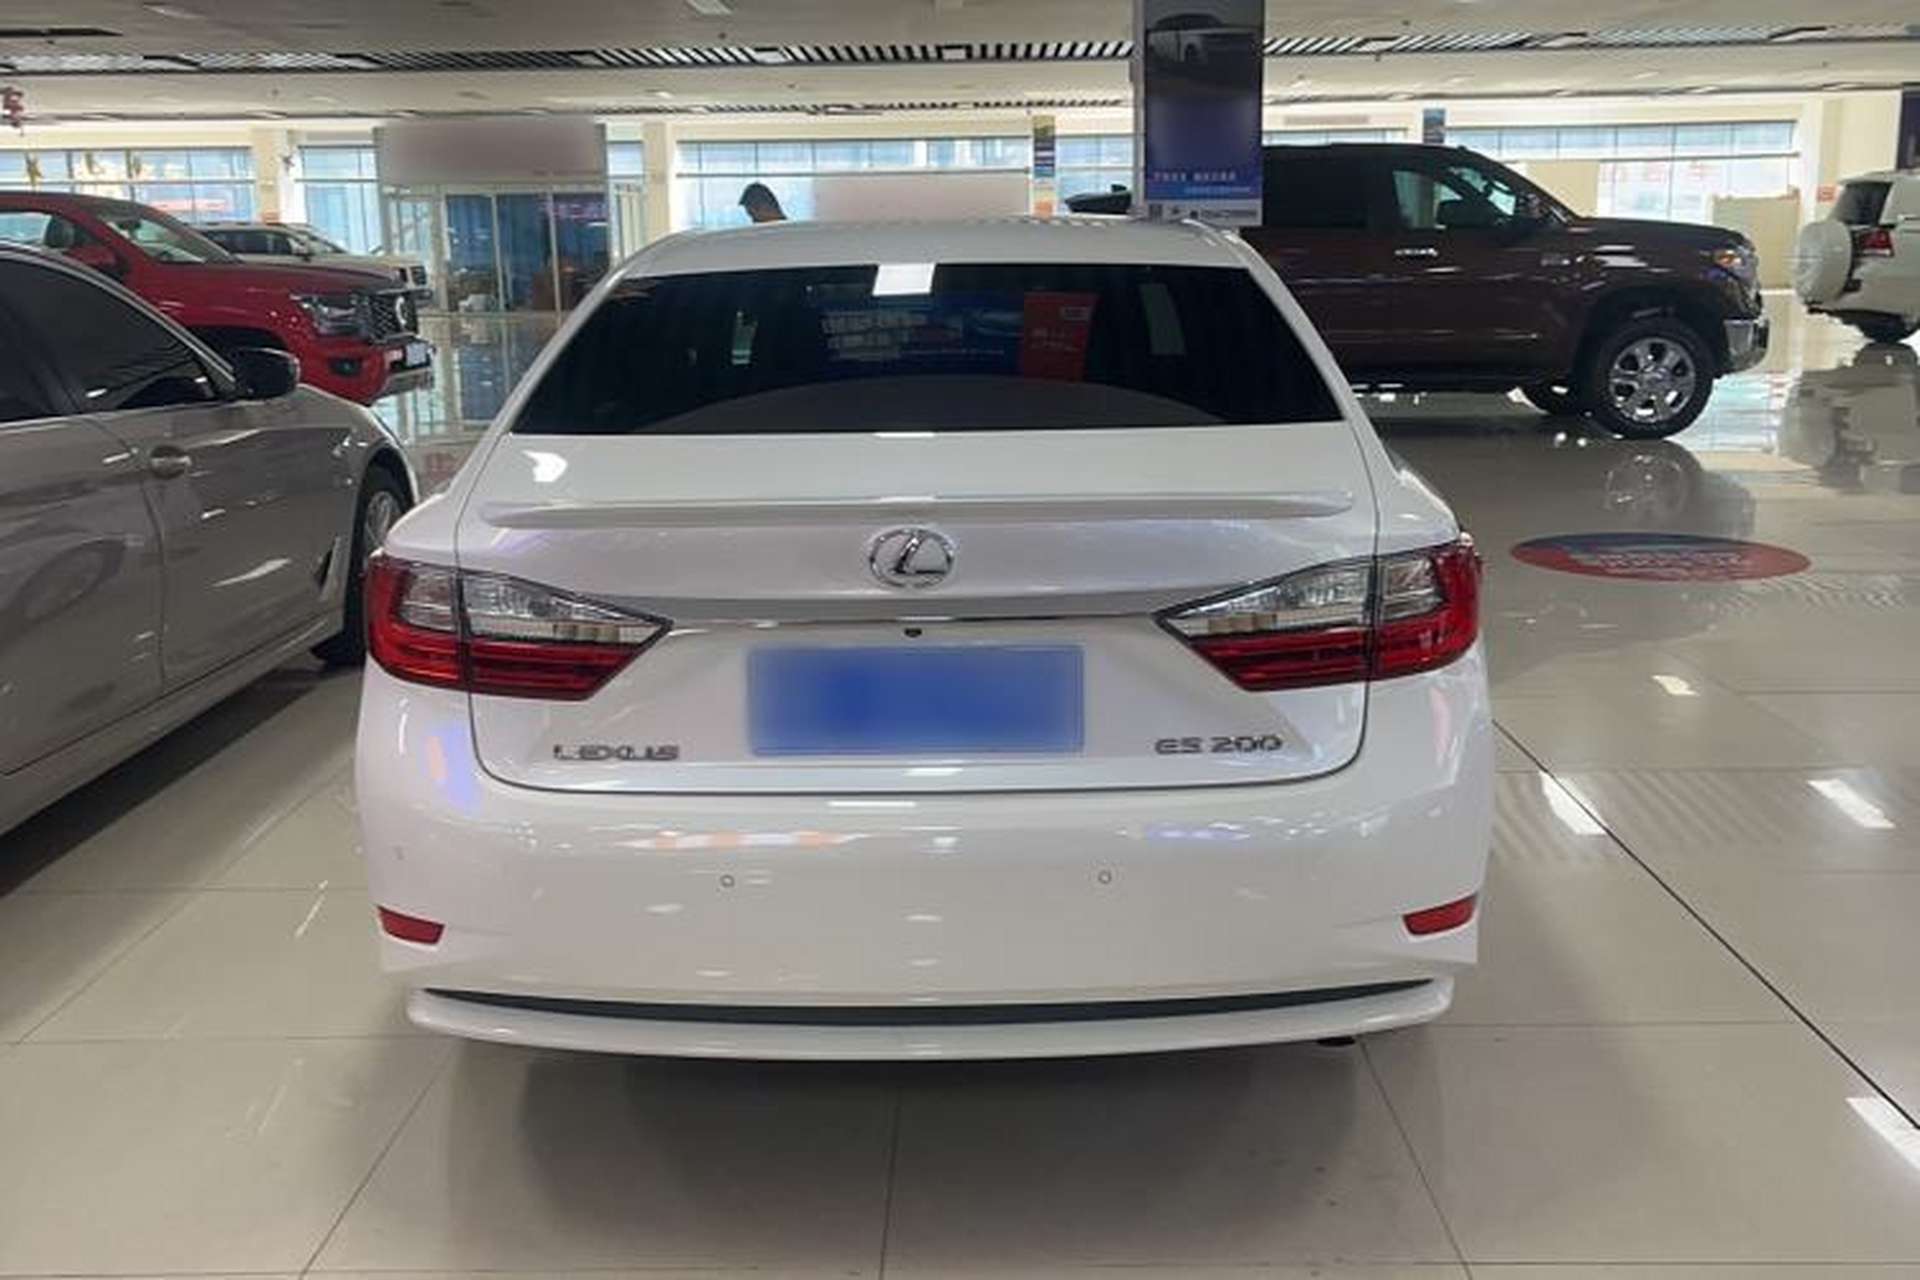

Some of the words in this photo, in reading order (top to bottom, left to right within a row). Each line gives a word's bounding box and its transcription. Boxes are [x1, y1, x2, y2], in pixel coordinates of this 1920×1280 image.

[553, 744, 680, 761] LEXUS
[1155, 737, 1203, 755] ES
[1210, 734, 1283, 753] 200
